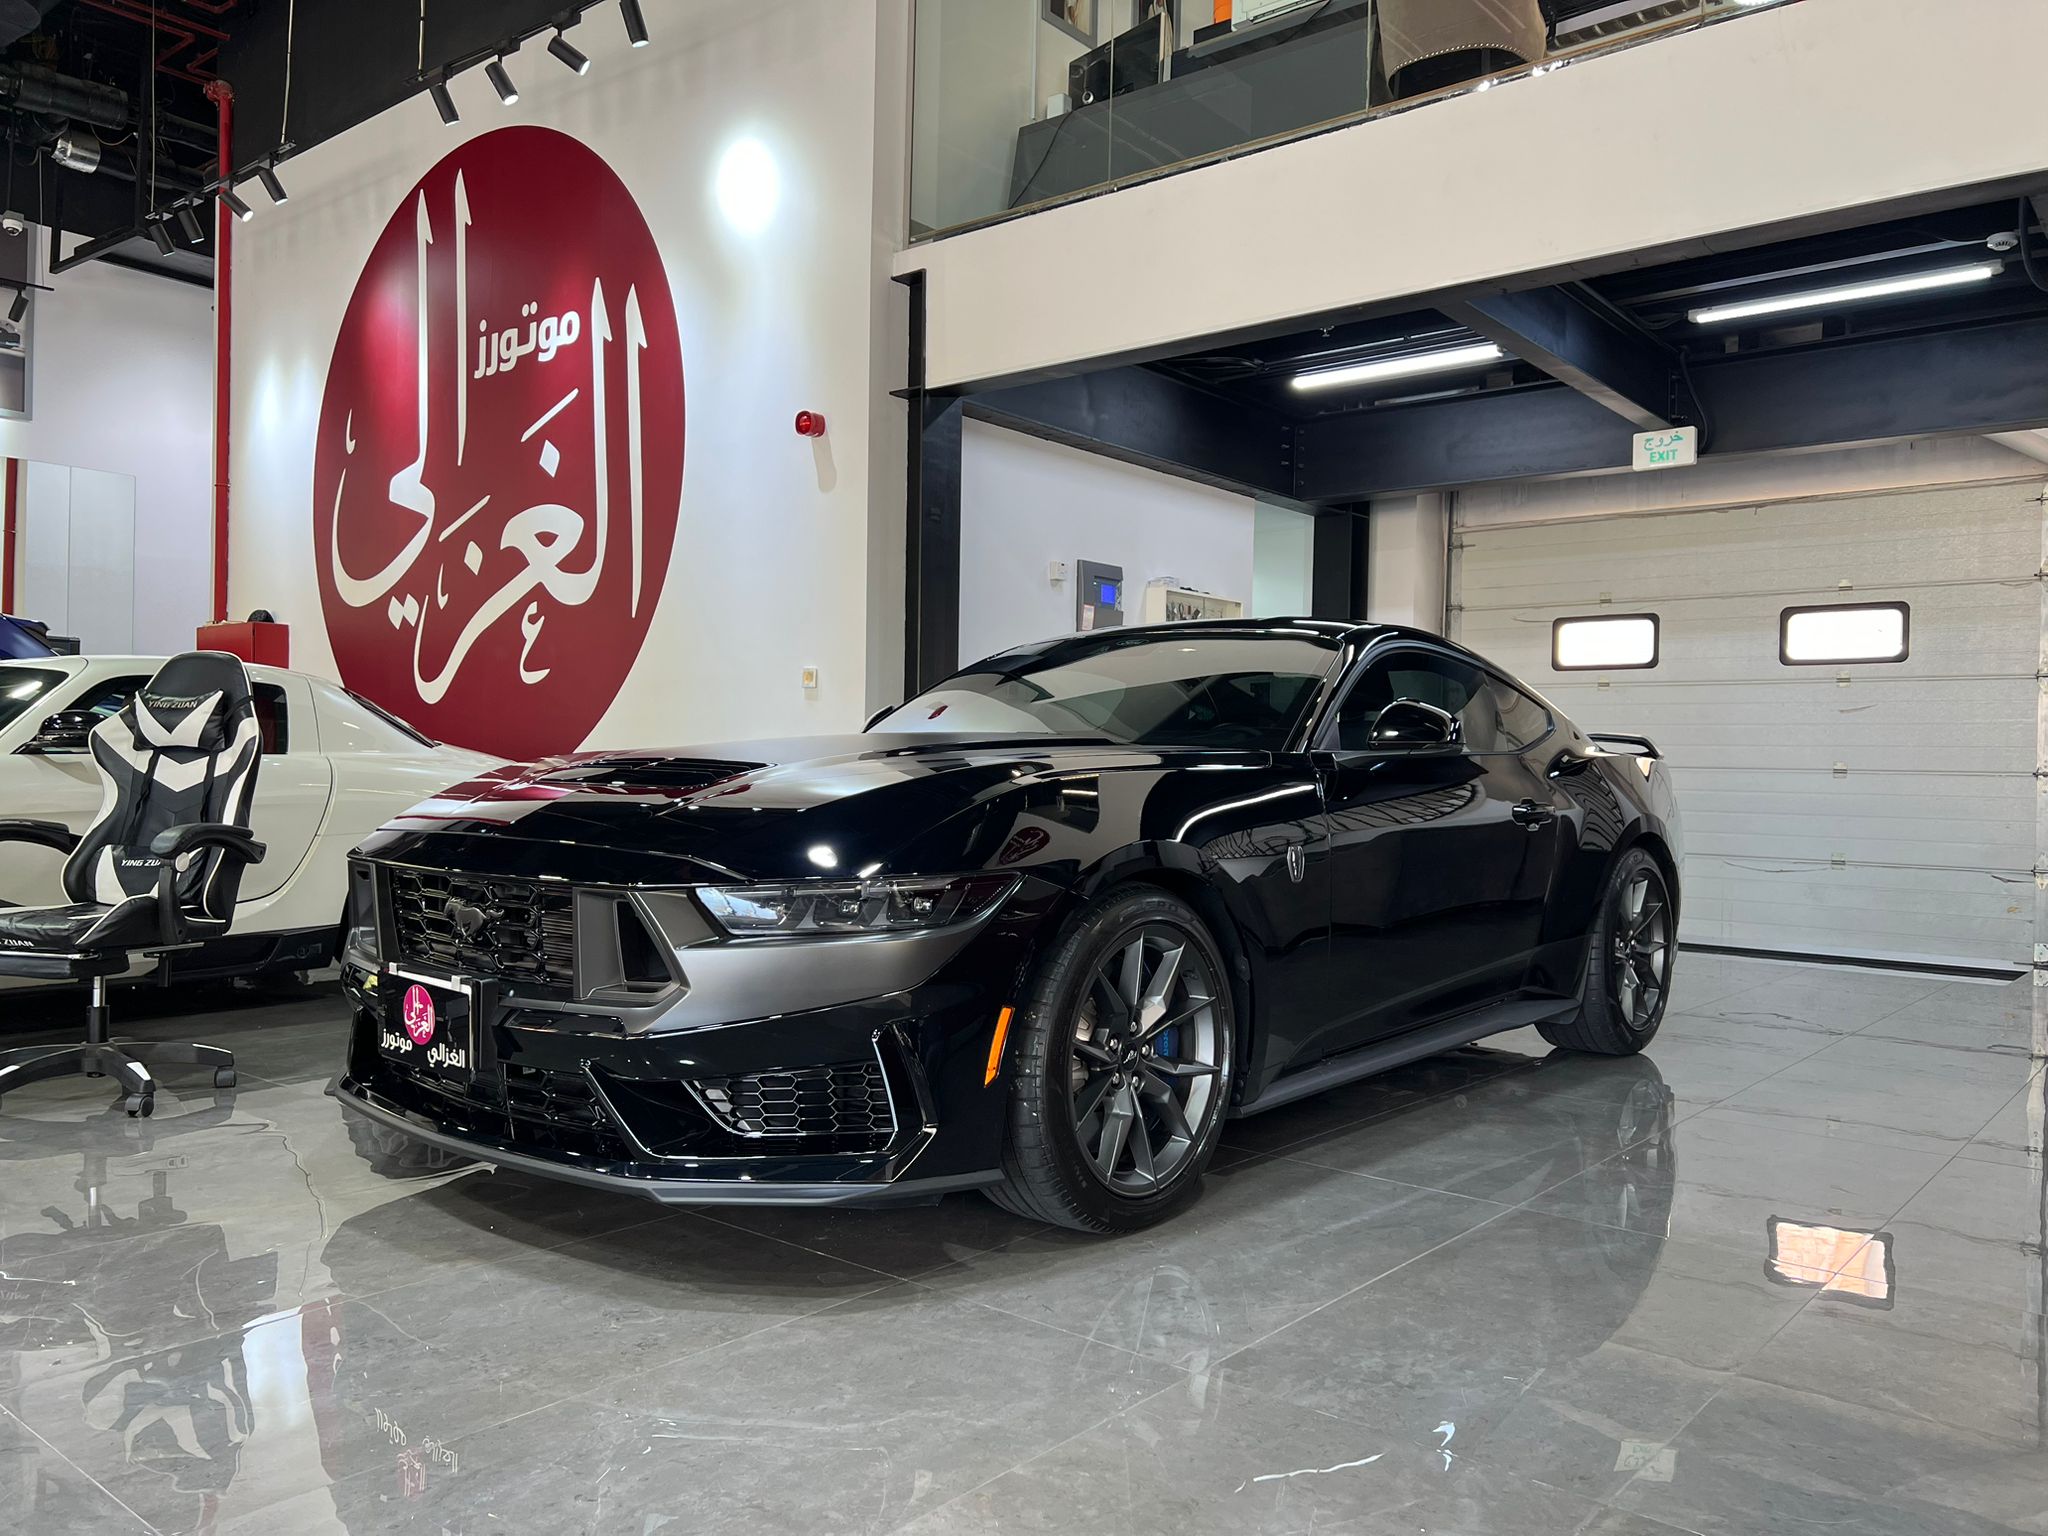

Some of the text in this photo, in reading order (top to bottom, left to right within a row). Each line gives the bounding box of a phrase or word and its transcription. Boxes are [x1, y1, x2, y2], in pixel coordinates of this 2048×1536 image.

[474, 301, 580, 380] موتورز
[1643, 431, 1684, 451] خروج
[1649, 449, 1678, 463] EXIT
[171, 700, 198, 708] ZUAN
[381, 1028, 466, 1069] الغزالي موتورز
